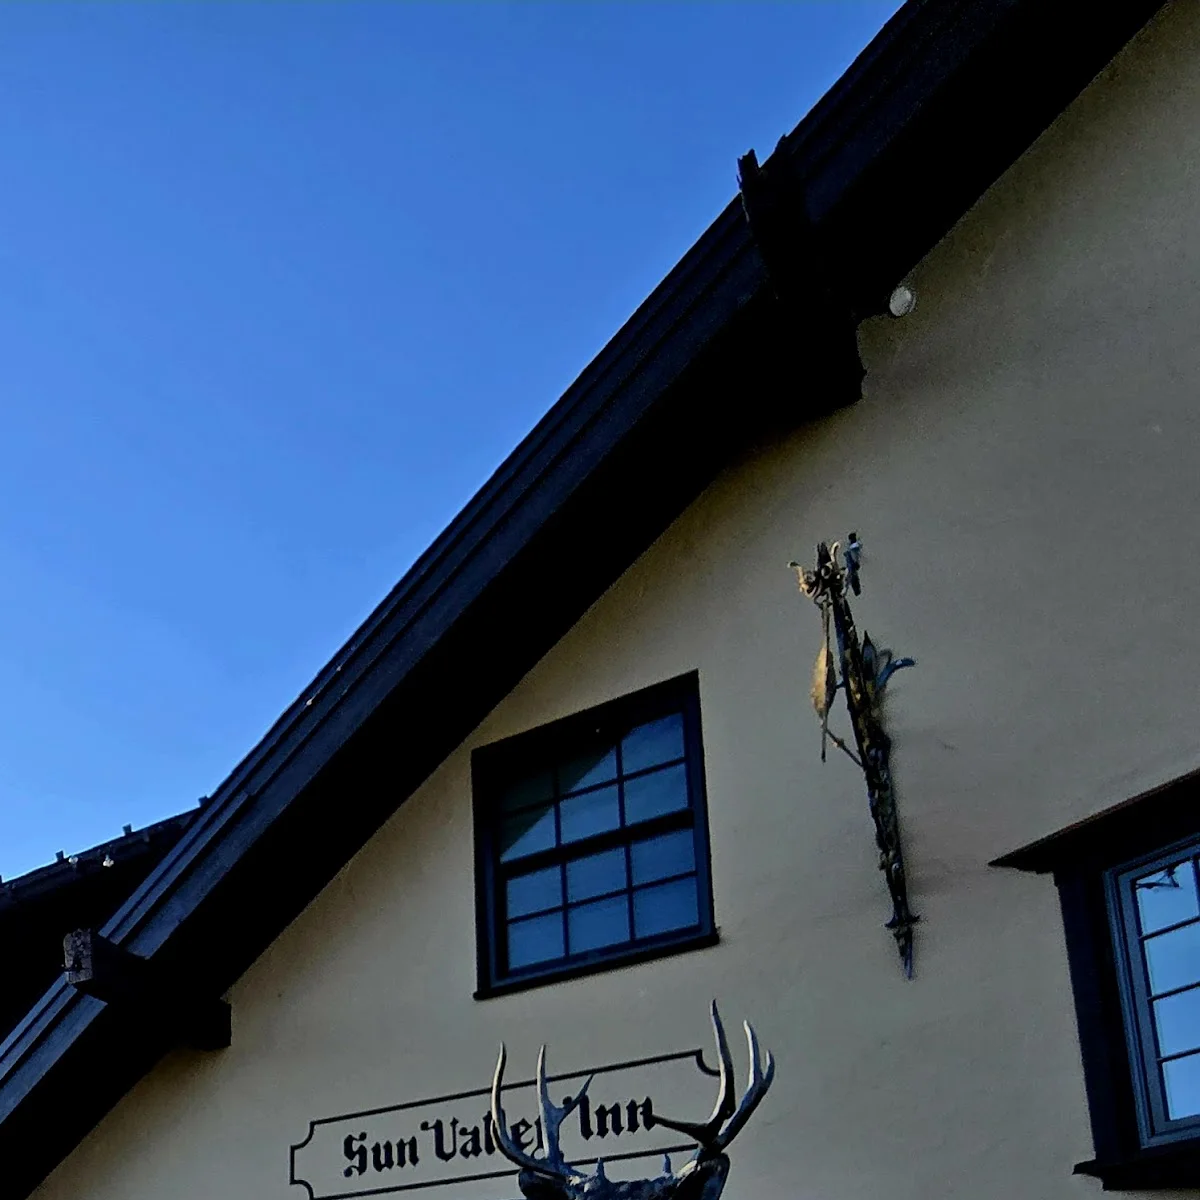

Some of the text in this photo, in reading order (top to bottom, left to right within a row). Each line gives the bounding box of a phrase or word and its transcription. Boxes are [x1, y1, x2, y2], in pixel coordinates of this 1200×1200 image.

[343, 1095, 657, 1178] Sun Vale Inn
